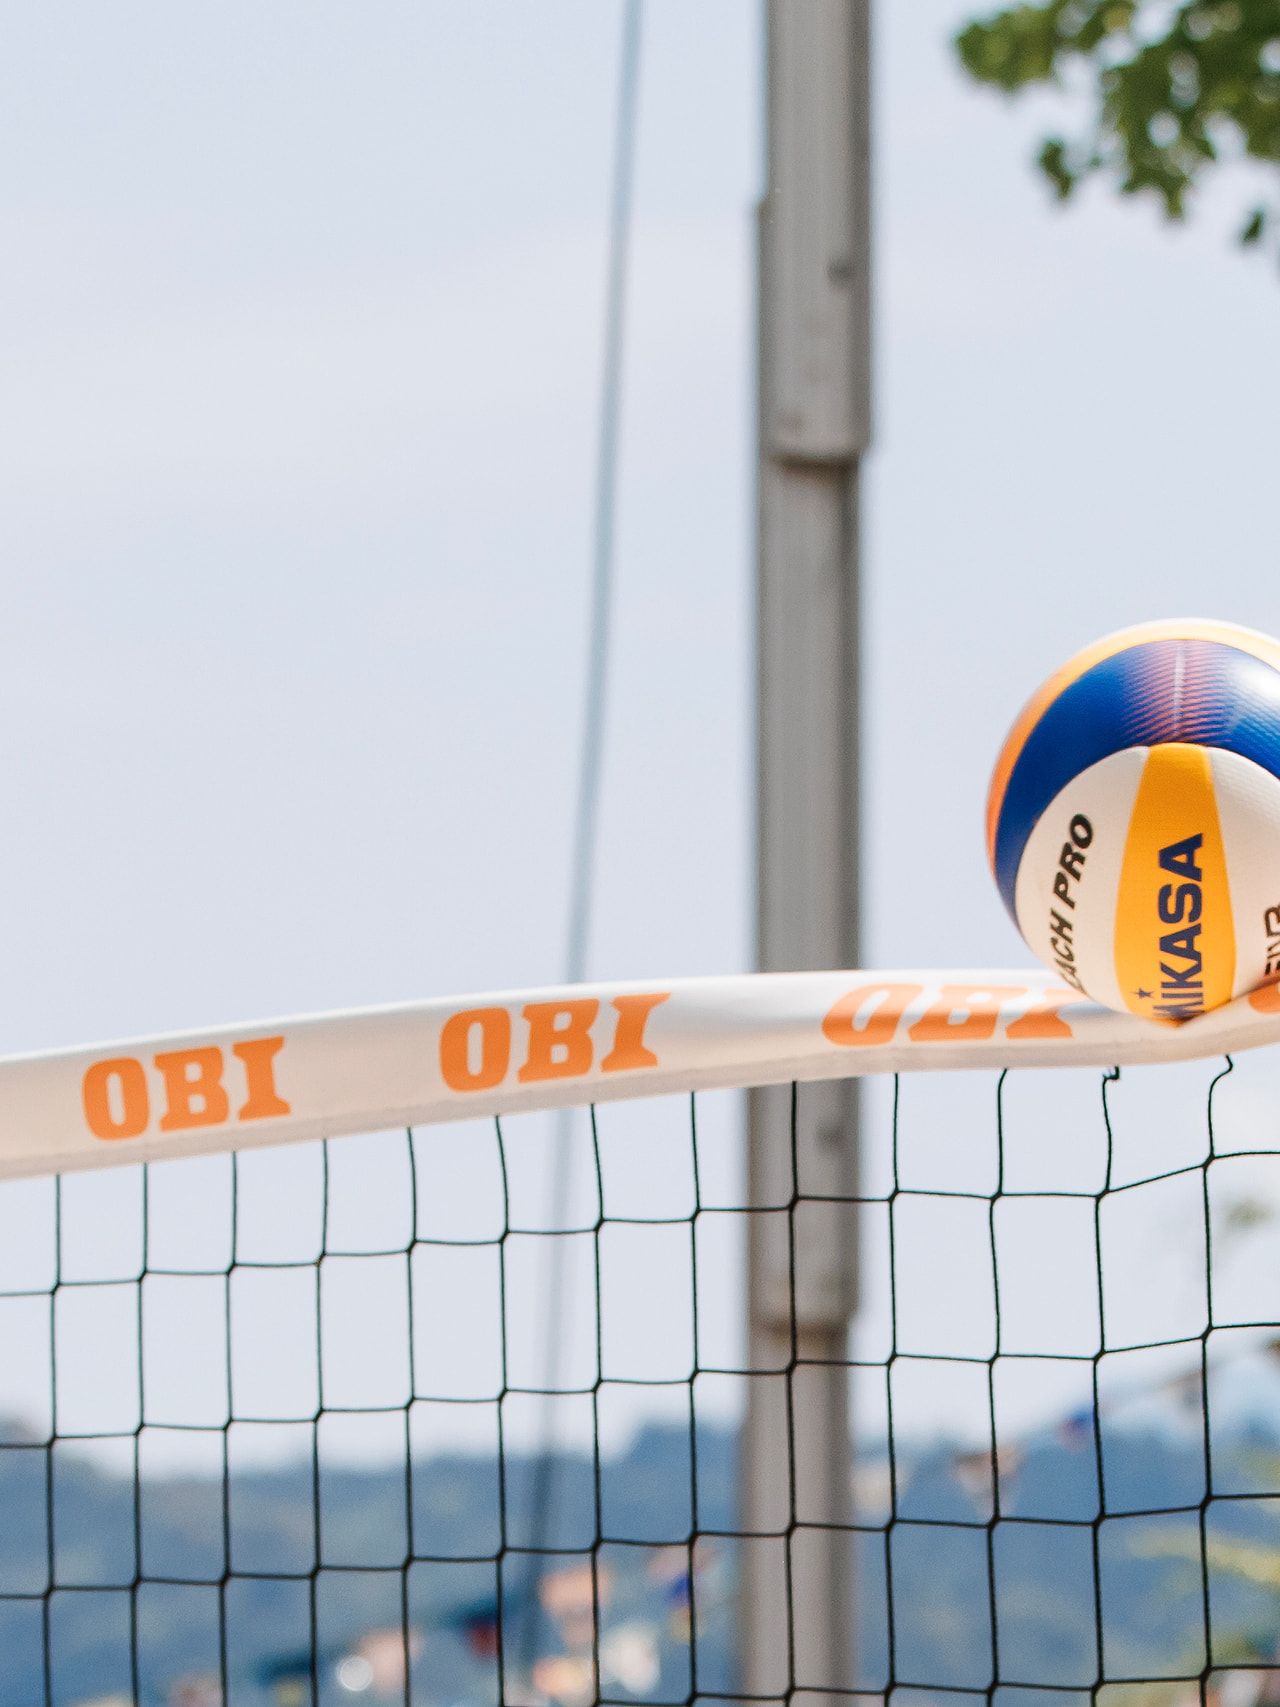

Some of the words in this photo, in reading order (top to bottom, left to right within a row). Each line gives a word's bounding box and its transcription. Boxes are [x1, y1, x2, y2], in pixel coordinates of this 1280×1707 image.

[1053, 814, 1093, 910] PRO
[1152, 833, 1204, 1017] MIKASA
[438, 992, 672, 1094] OBI
[820, 983, 1088, 1047] OBI
[81, 1034, 292, 1142] OBI
